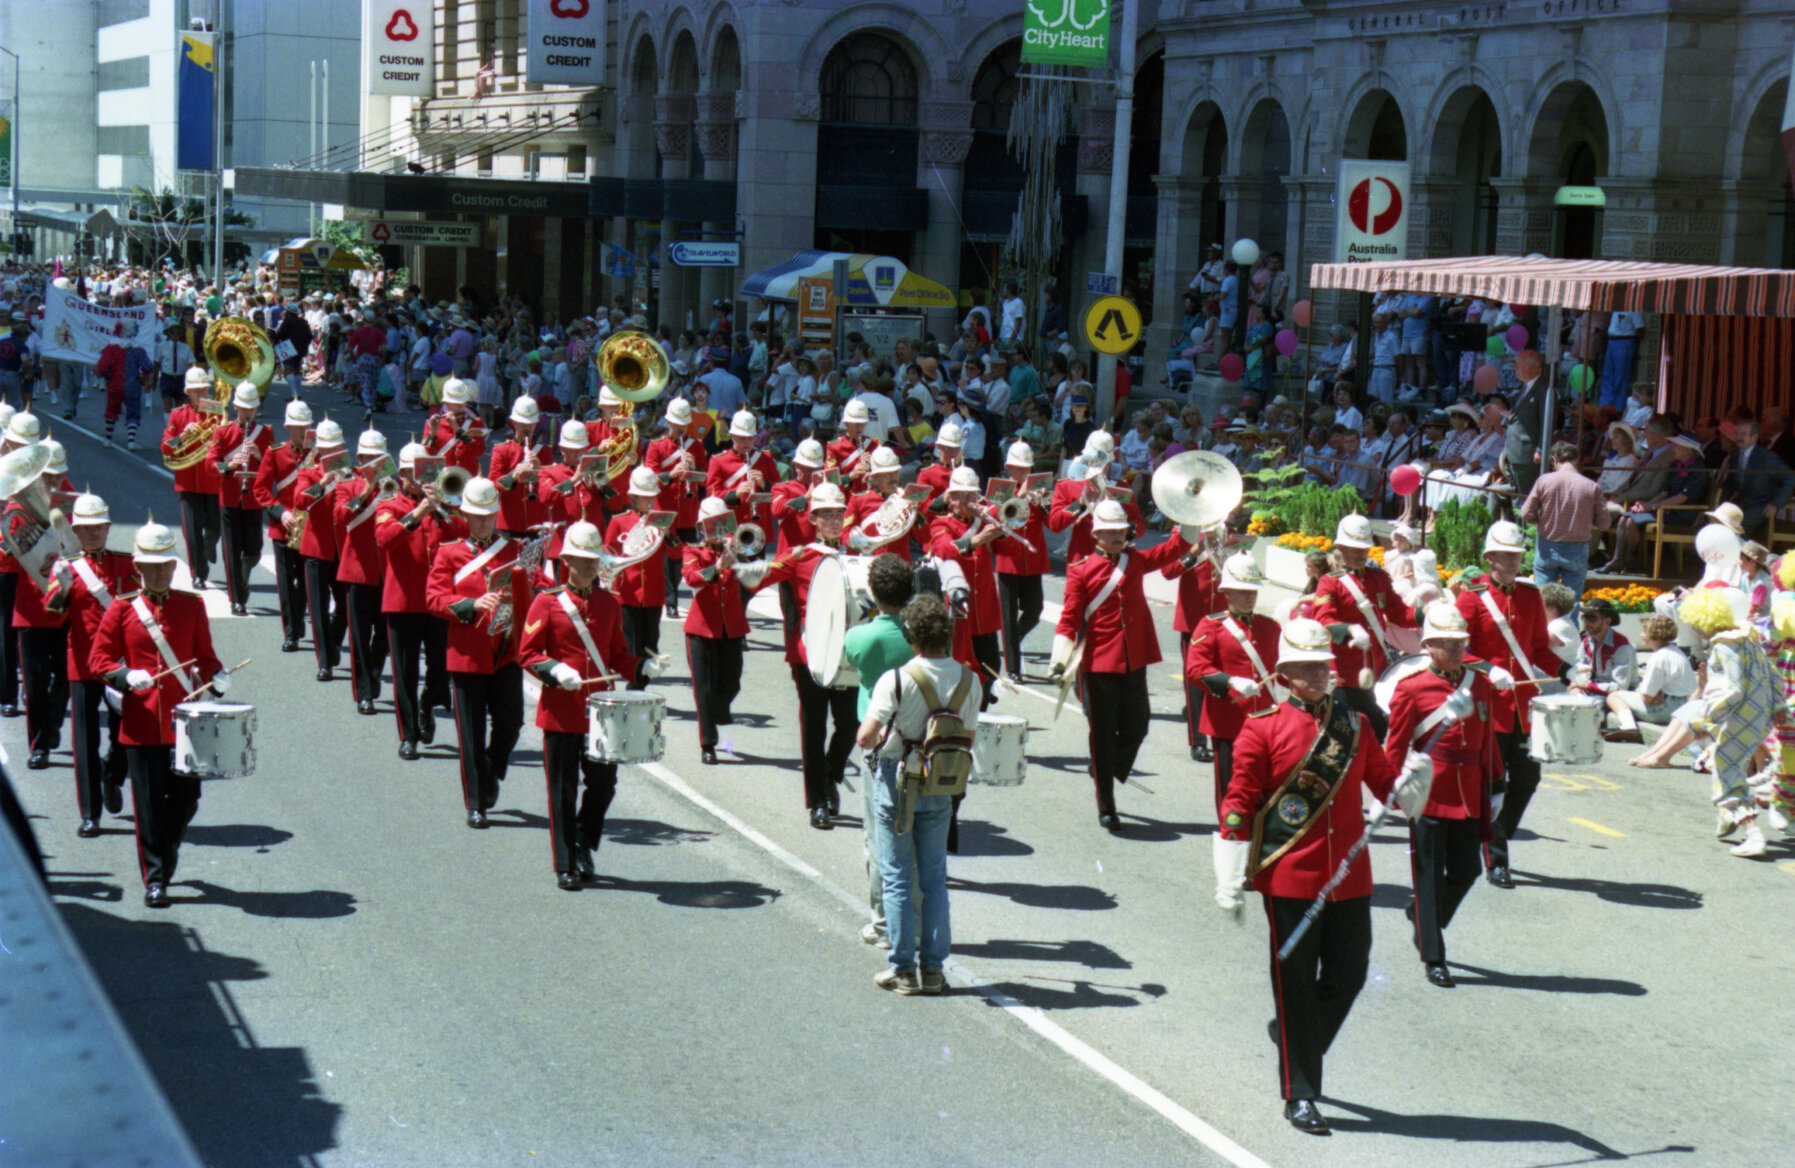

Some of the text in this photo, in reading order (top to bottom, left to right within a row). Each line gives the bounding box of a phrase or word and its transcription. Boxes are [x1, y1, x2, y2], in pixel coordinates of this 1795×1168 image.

[1460, 7, 1505, 22] POST
[542, 35, 596, 48] CUSTOM
[379, 55, 424, 66] CUSTOM
[546, 54, 592, 67] CREDIT
[382, 70, 421, 82] CREDIT
[452, 192, 548, 209] Custom Credit
[393, 224, 473, 236] CUSTOM CREDIT
[1348, 242, 1397, 254] Australia
[899, 288, 915, 298] Post
[916, 288, 938, 299] Office
[64, 296, 145, 320] QUEENSLAND
